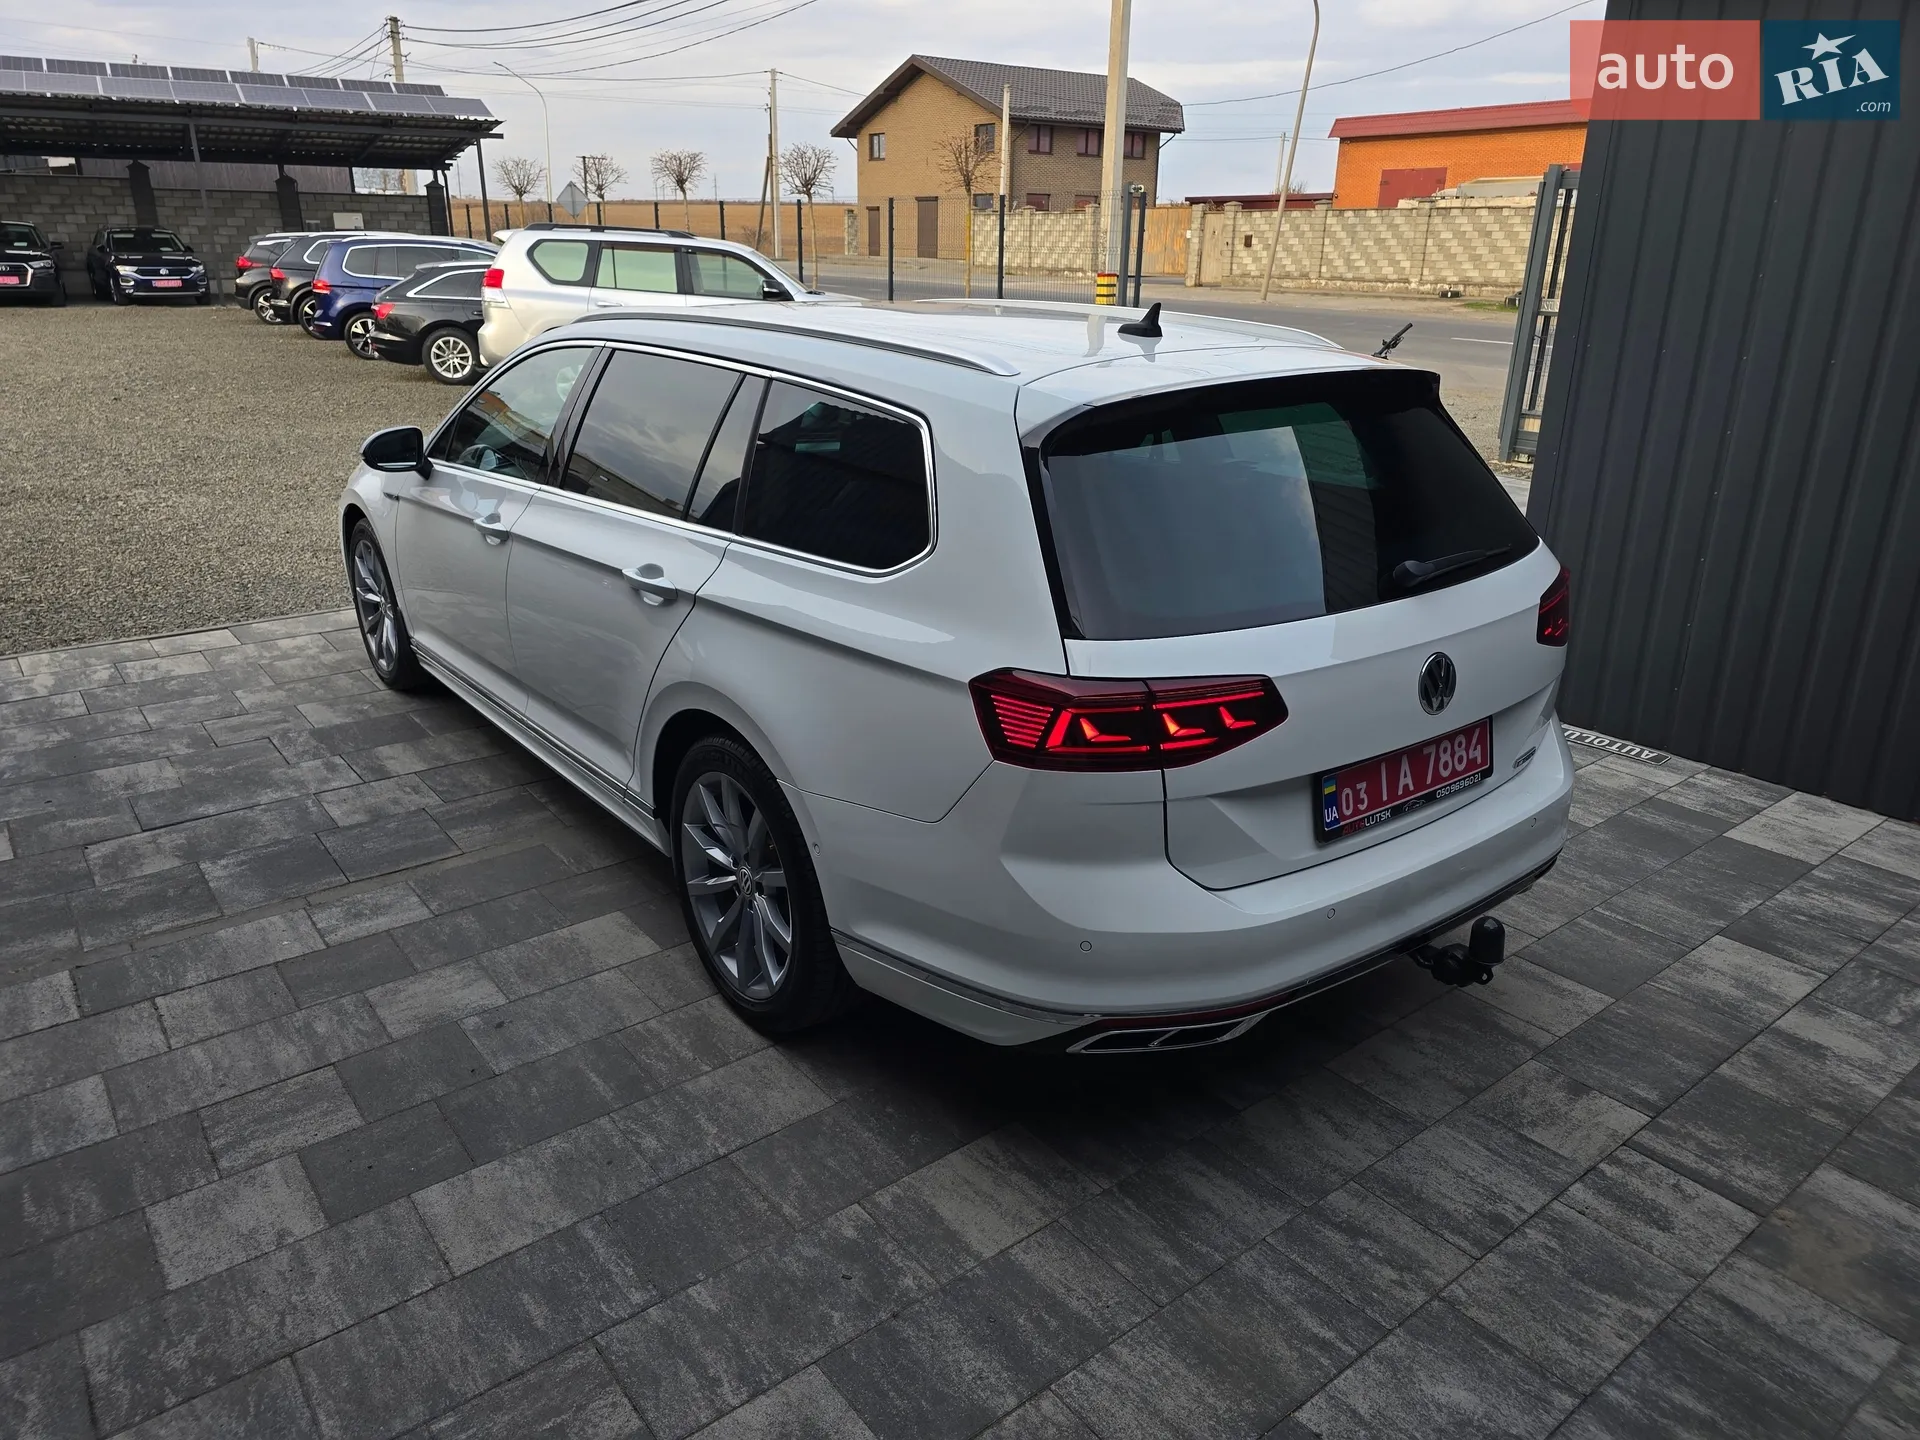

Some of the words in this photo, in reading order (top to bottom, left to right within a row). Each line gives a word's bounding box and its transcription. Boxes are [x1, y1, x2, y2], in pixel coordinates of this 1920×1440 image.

[1341, 781, 1368, 816] 03
[1422, 727, 1482, 785] 7884
[1324, 806, 1339, 822] UA
